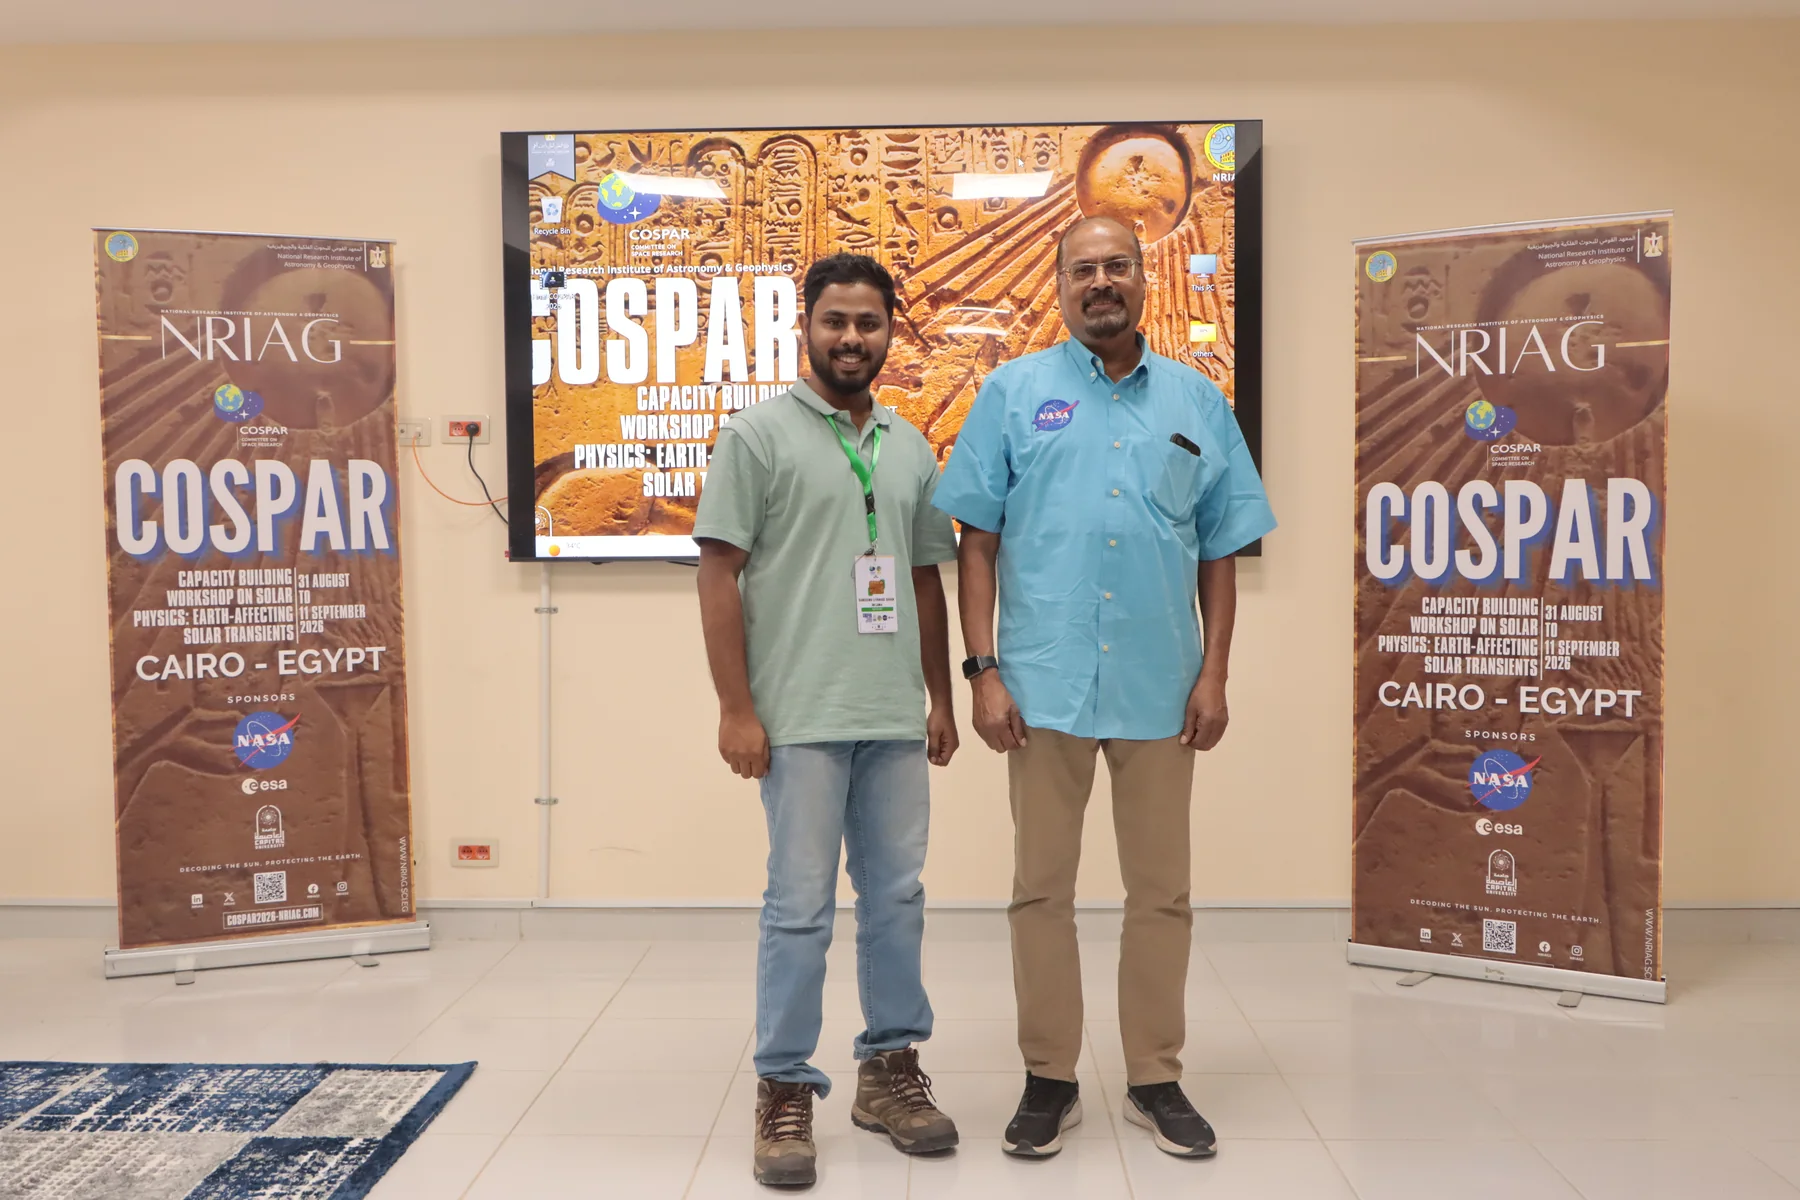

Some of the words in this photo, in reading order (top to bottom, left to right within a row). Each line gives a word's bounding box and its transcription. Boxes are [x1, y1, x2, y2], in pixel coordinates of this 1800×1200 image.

[534, 228, 558, 236] Recycle
[629, 228, 690, 240] COSPAR
[1538, 252, 1566, 260] National
[1567, 250, 1596, 258] Research
[1598, 247, 1625, 255] Institute
[1545, 260, 1580, 268] Astronomy
[1589, 256, 1626, 266] Geophysics
[323, 262, 356, 270] Geophysics
[559, 265, 605, 275] Research
[607, 265, 651, 274] Institute
[654, 264, 665, 274] of
[666, 263, 723, 276] Astronomy
[726, 263, 733, 273] &
[735, 262, 793, 275] Geophysics
[1191, 284, 1204, 292] This
[160, 314, 342, 364] NRIAG
[1192, 350, 1214, 358] others
[1416, 321, 1606, 379] NRIAG
[636, 385, 716, 411] CAPACITY
[1039, 411, 1070, 421] NASA
[240, 426, 289, 435] COSPAR
[620, 414, 714, 440] WORKSHOP
[574, 444, 651, 469] PHYSICS:
[1491, 443, 1542, 454] COSPAR
[643, 472, 695, 497] SOLAR
[115, 458, 390, 555] COSPAR
[1366, 477, 1652, 580] COSPAR
[178, 570, 235, 588] CAPACITY
[238, 568, 292, 587] BUILDING
[298, 574, 310, 589] 31
[312, 572, 350, 588] AUGUST
[167, 589, 233, 607] WORKSHOP
[237, 588, 253, 605] ON
[256, 587, 293, 604] SOLAR
[298, 590, 311, 604] TO
[299, 606, 309, 621] 11
[312, 604, 366, 620] SEPTEMBER
[1422, 596, 1480, 615] CAPACITY
[1482, 598, 1538, 616] BUILDING
[1545, 605, 1558, 621] 31
[1561, 605, 1603, 622] AUGUST
[133, 610, 190, 628] PHYSICS:
[193, 606, 294, 626] EARTH-AFFECTING
[184, 627, 221, 645] SOLAR
[224, 624, 294, 644] TRANSIENTS
[300, 620, 324, 634] 2026
[1410, 616, 1477, 635] WORKSHOP
[1480, 618, 1496, 635] ON
[1500, 618, 1538, 636] SOLAR
[1545, 622, 1558, 638] TO
[1378, 635, 1431, 654] PHYSICS:
[1434, 637, 1538, 657] EARTH-AFFECTING
[1545, 640, 1555, 655] 11
[1558, 641, 1620, 658] SEPTEMBER
[136, 652, 245, 681] CAIRO
[278, 646, 386, 676] EGYPT
[1424, 656, 1462, 674] SOLAR
[1465, 657, 1538, 676] TRANSIENTS
[1545, 656, 1571, 671] 2026
[227, 693, 296, 704] SPONSORS
[1378, 681, 1485, 711] CAIRO
[1520, 686, 1642, 717] EGYPT
[238, 732, 291, 748] NASA
[1465, 730, 1536, 742] SPONSORS
[1474, 771, 1529, 788] NASA
[180, 864, 222, 873] DECODING
[265, 856, 315, 866] PROTECTING
[1486, 884, 1517, 892] CAPITAL
[227, 907, 319, 926] COSPAR2026-NRIAG.COM
[1410, 899, 1452, 908] DECODING
[1473, 905, 1492, 913] SUN.
[1495, 908, 1548, 918] PROTECTING
[1552, 913, 1568, 921] THE
[1572, 915, 1602, 924] EARTH.
